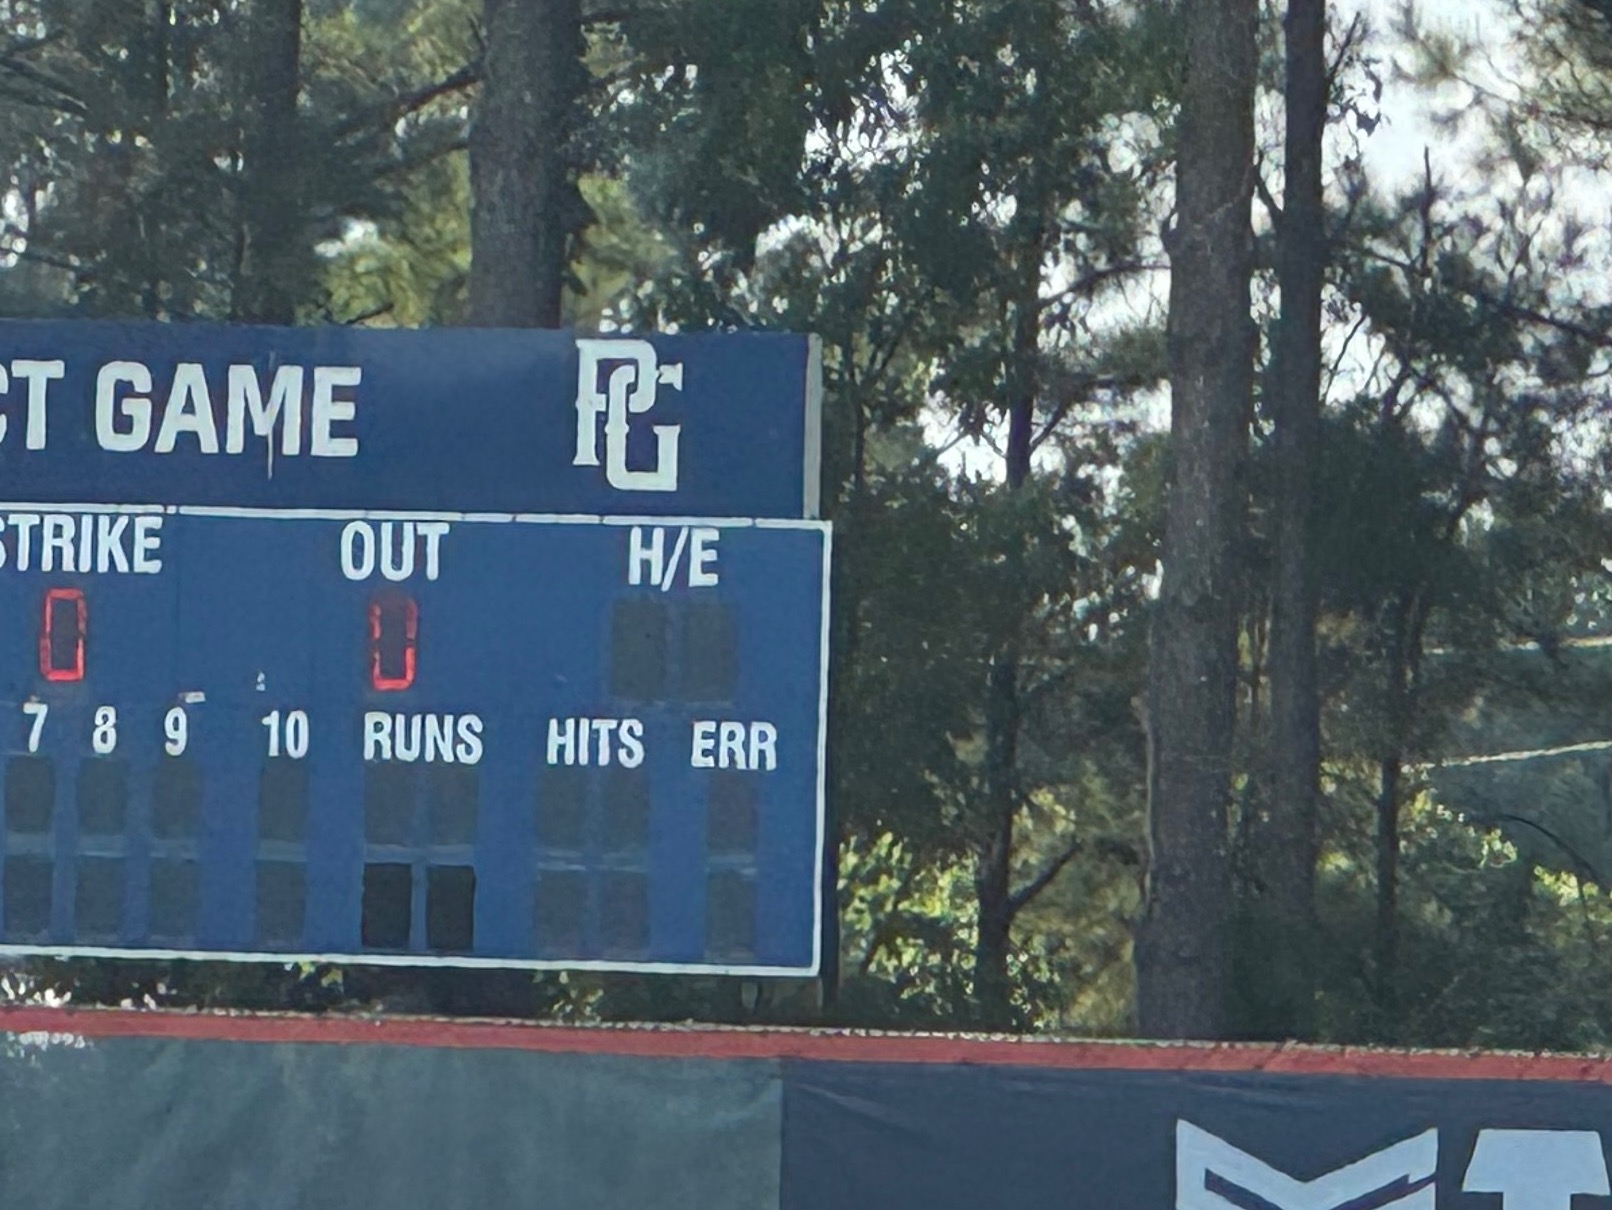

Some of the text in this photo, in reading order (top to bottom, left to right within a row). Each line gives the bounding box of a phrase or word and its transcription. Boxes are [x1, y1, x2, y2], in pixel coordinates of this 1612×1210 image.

[0, 360, 362, 456] T GAME
[0, 514, 163, 574] TRIKE
[340, 521, 450, 581] OUT
[628, 526, 720, 592] H/E
[40, 587, 87, 682] 0
[23, 702, 778, 771] 7 8 9 10 RUNS HITS ERR
